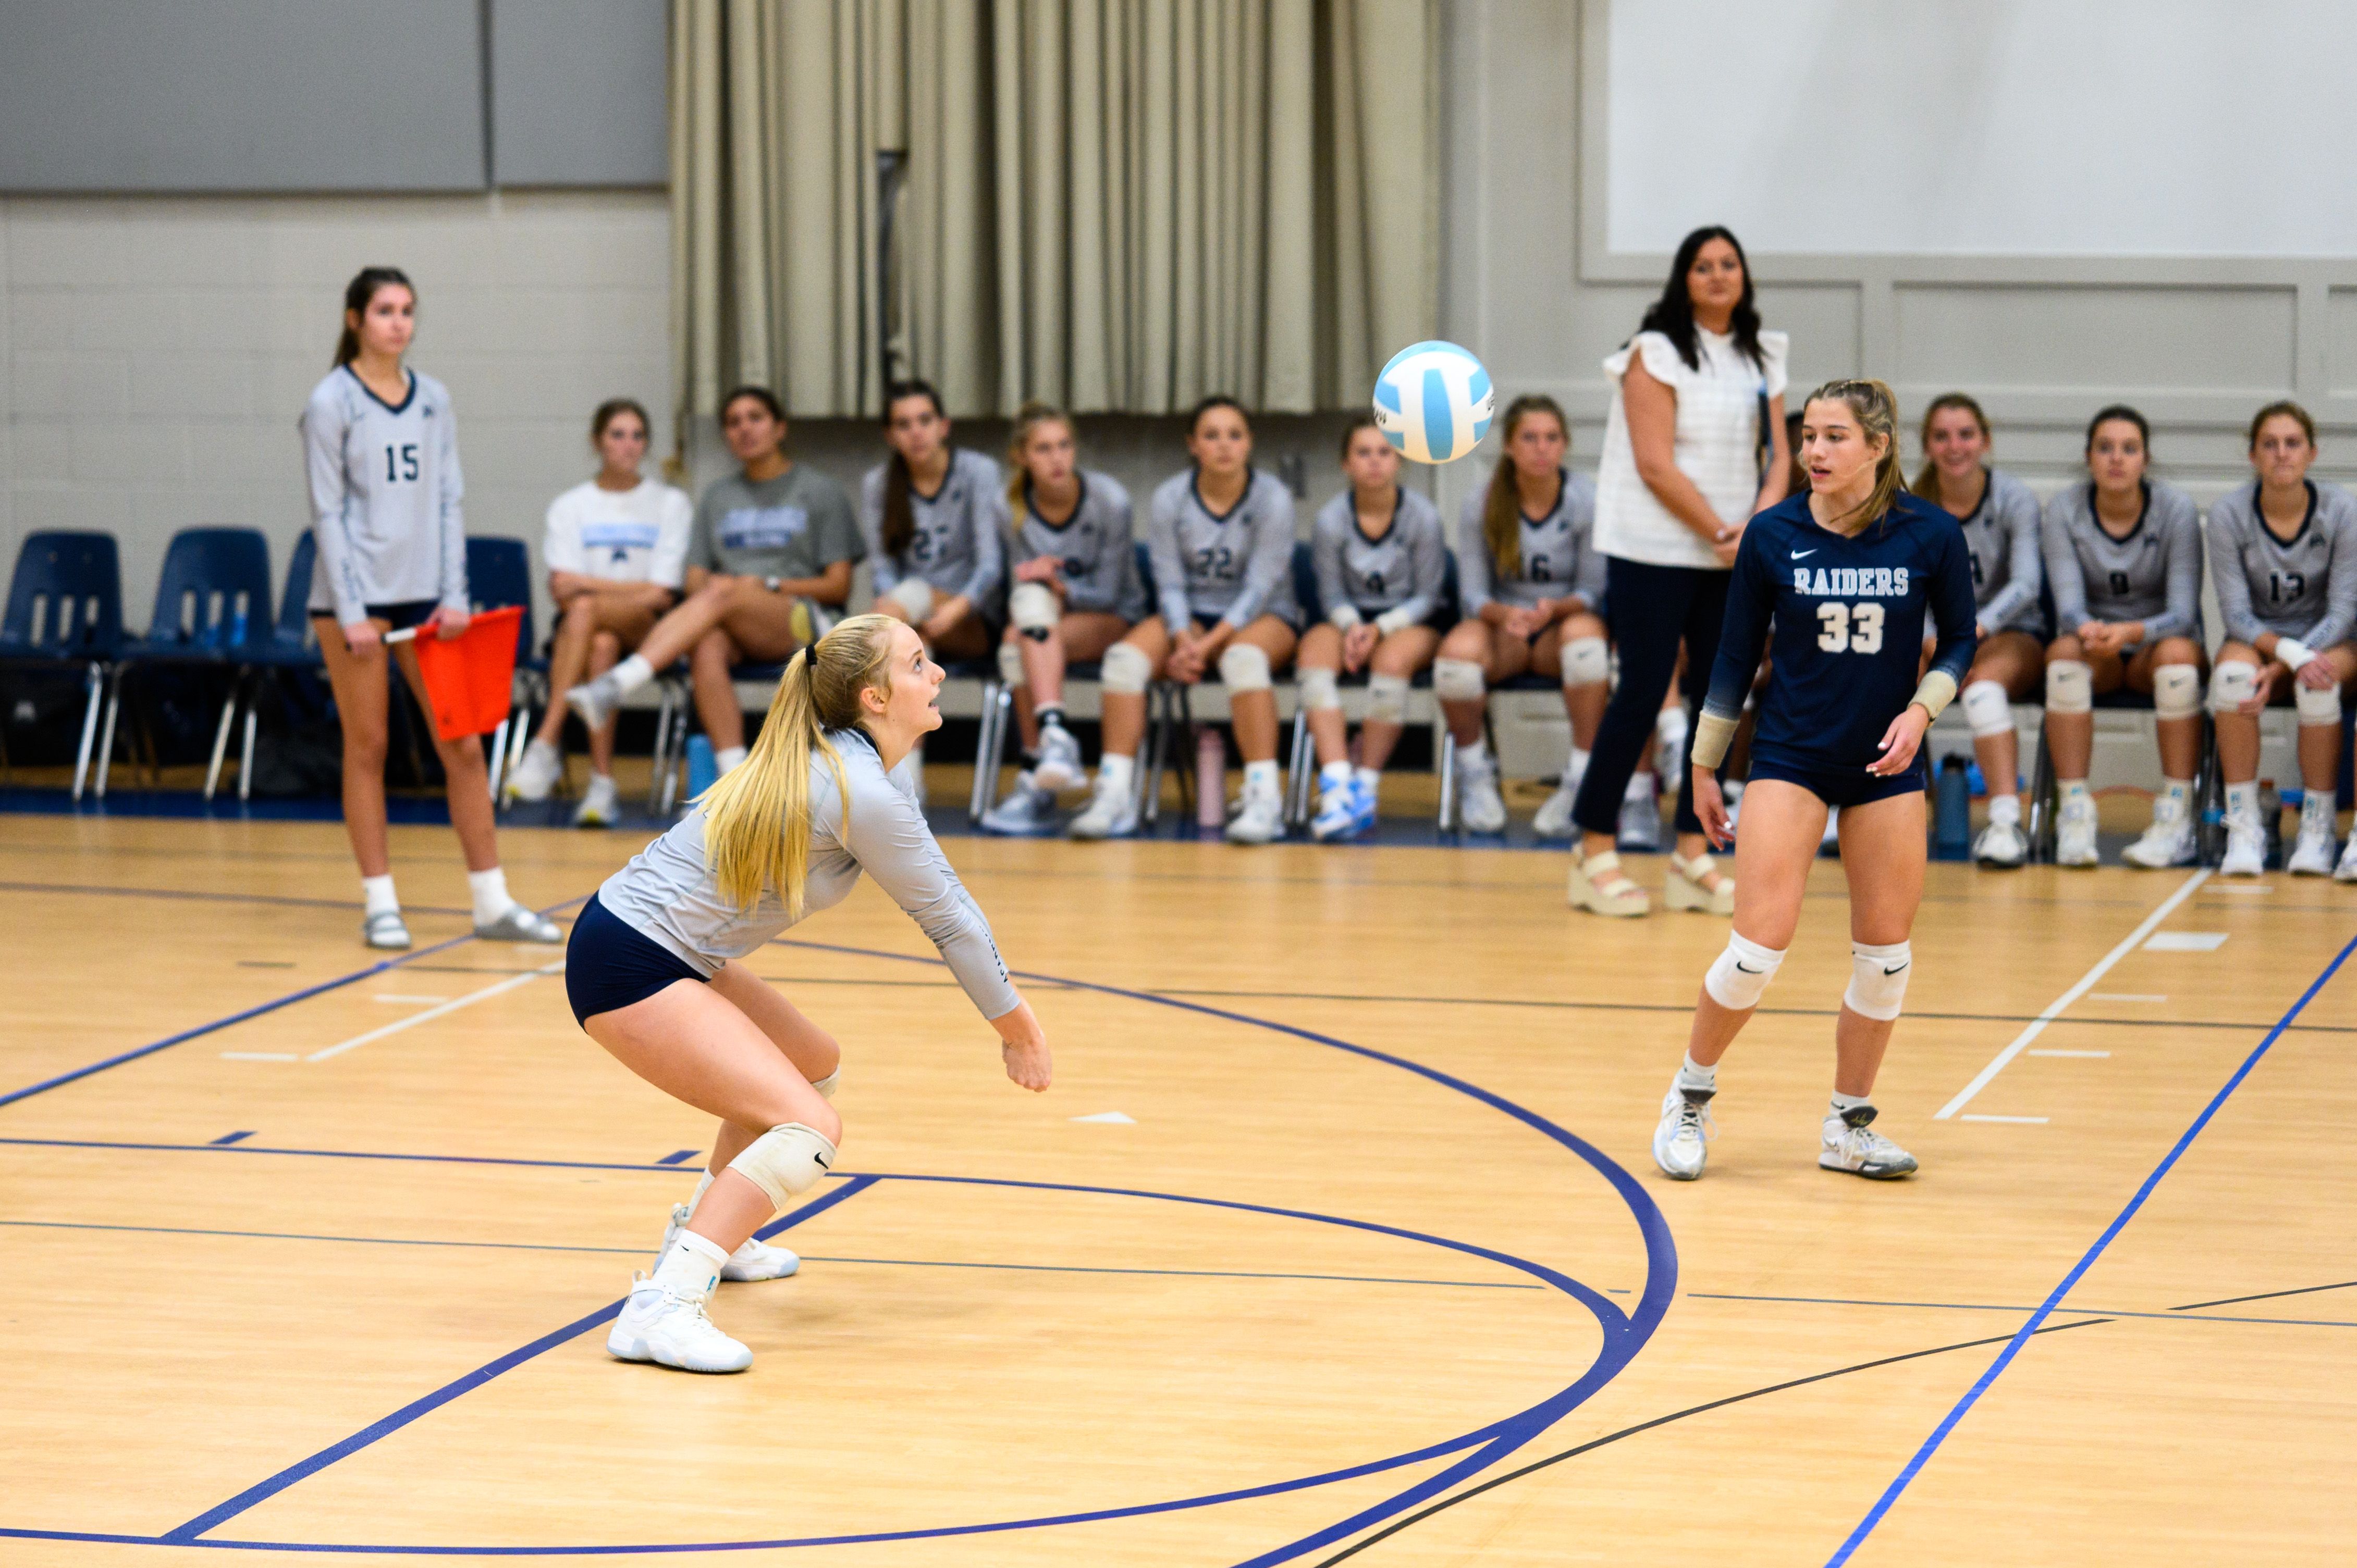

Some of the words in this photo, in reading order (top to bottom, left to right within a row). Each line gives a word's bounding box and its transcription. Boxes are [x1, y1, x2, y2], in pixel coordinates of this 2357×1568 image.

[385, 445, 418, 482] 15
[1197, 547, 1234, 579] 22
[1531, 553, 1552, 582] 6
[1794, 567, 1909, 596] RAIDERS
[2269, 572, 2304, 603] 13
[1816, 601, 1885, 655] 33
